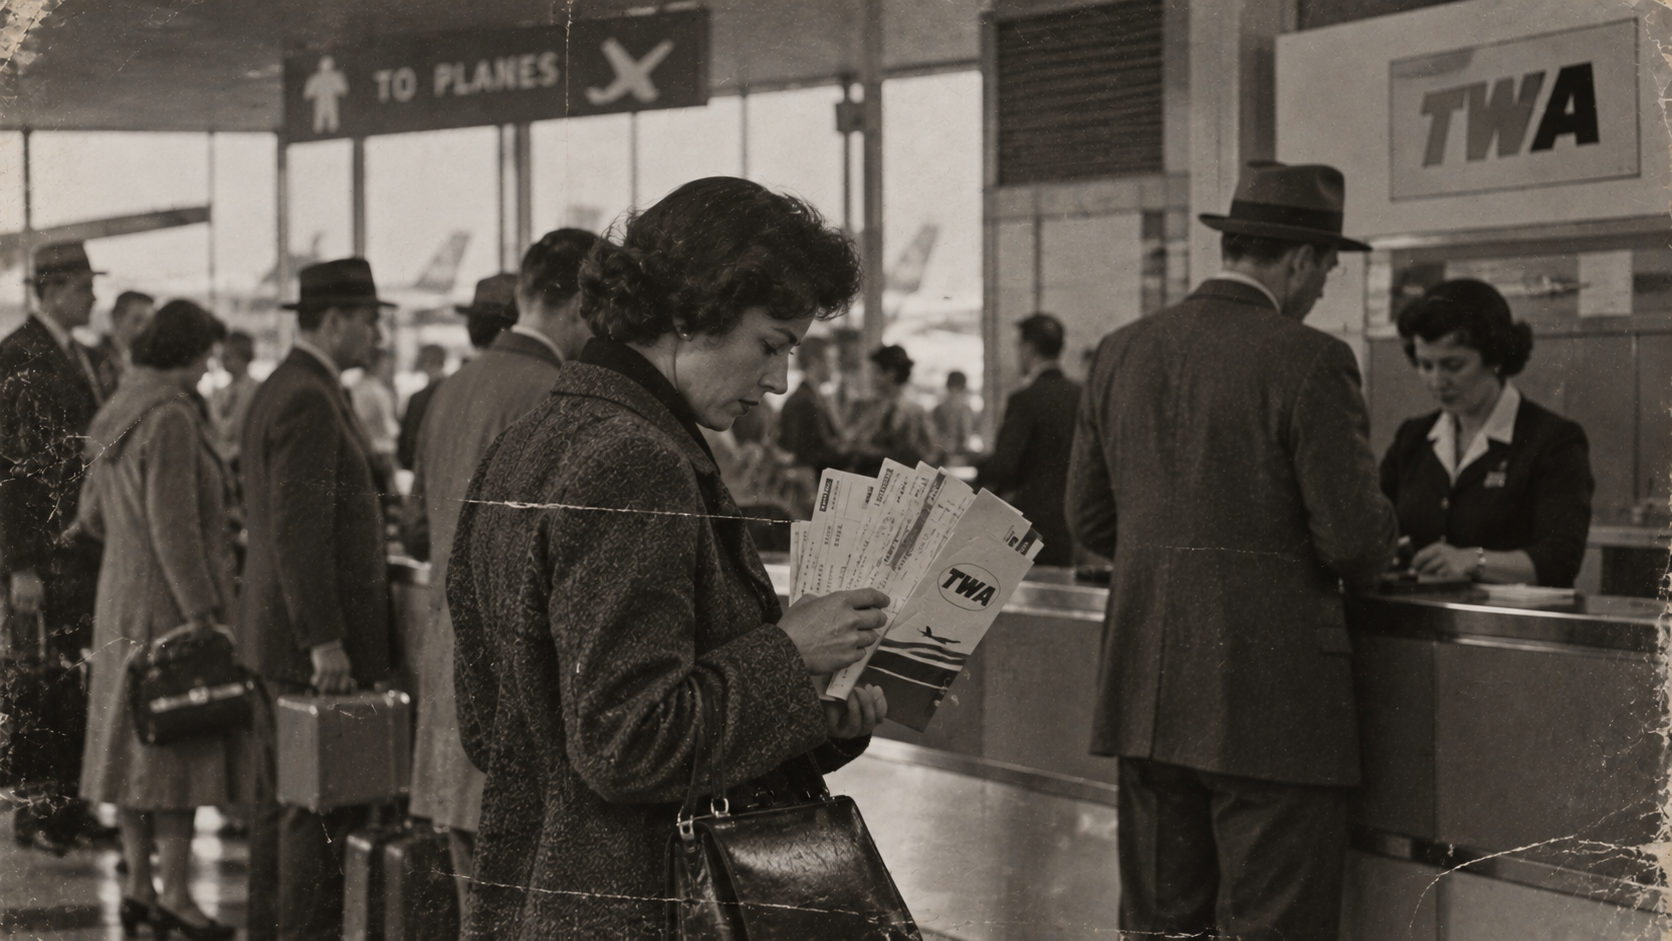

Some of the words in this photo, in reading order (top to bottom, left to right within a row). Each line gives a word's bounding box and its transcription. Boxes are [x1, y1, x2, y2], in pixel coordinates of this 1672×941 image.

[373, 67, 417, 102] TO
[433, 51, 560, 98] PLANES
[1420, 61, 1600, 169] TWA
[941, 567, 997, 607] TWA
